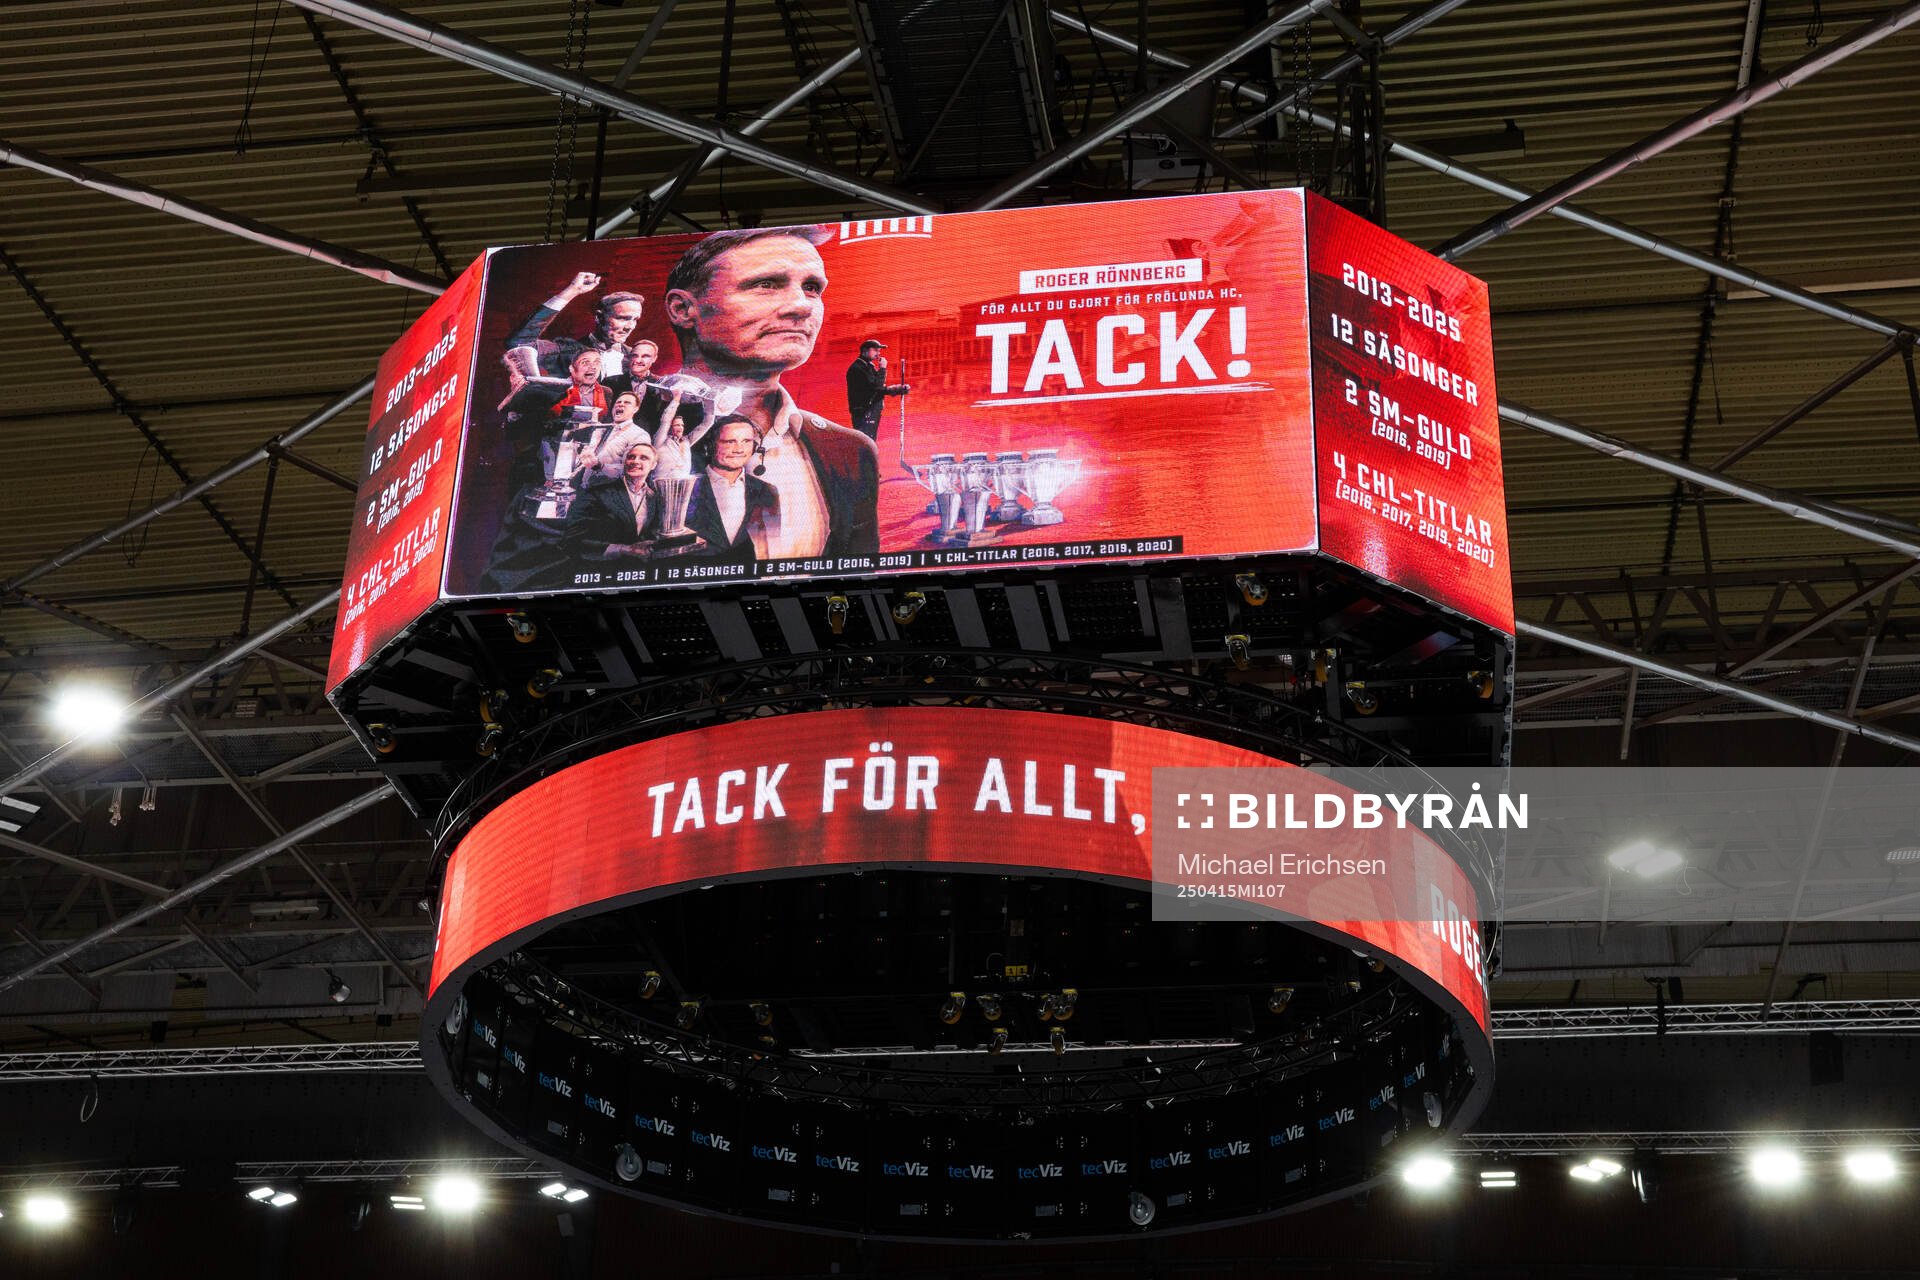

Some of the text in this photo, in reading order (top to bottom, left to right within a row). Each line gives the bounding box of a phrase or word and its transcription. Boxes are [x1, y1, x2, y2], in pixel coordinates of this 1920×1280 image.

[1035, 266, 1186, 288] ROGER RÖNNBERG
[981, 303, 1007, 315] FÖR
[1010, 302, 1041, 313] ALLT
[1047, 300, 1063, 311] DU
[1069, 297, 1110, 309] GJORT
[1116, 292, 1140, 305] FÖR
[1146, 288, 1214, 303] FRÖLUNDA
[1342, 262, 1461, 342] 2013-2025
[975, 306, 1252, 394] TACK!
[1331, 313, 1478, 406] 12 SÄSONGER
[385, 325, 458, 413] 2013-2025
[369, 374, 458, 476] 12 SÄSONGER
[1345, 378, 1472, 460] 2 SM-GULD
[366, 438, 443, 527] 2 SM-GULD
[1333, 451, 1492, 547] 4 CHL-TITLAR
[347, 506, 441, 606] 4 CHL-TITLAR
[574, 573, 601, 584] 2013
[616, 570, 646, 581] 2025
[668, 568, 680, 579] 12
[684, 563, 745, 578] SÄSONGER
[766, 562, 774, 573] 2
[779, 559, 833, 572] SM-GULD
[934, 553, 942, 564] 4
[946, 549, 1017, 563] CHL-TITLAR
[647, 741, 1146, 838] TACK FÖR ALLT,
[473, 1018, 497, 1048] tecViz
[503, 1044, 528, 1075] tecViz
[539, 1071, 572, 1098] tecViz
[1403, 1061, 1425, 1088] tecVi
[584, 1091, 617, 1119] tecViz
[1368, 1085, 1395, 1112] tecViz
[634, 1112, 675, 1137] tecViz
[1318, 1107, 1355, 1130] tecViz
[690, 1128, 731, 1152] tecViz
[1269, 1124, 1305, 1147] tecViz
[752, 1144, 797, 1163] tecViz
[816, 1153, 861, 1173] tecViz
[1150, 1150, 1192, 1170] tecViz
[1208, 1140, 1250, 1160] tecViz
[882, 1161, 929, 1177] tecViz
[947, 1163, 994, 1180] tecViz
[1017, 1163, 1063, 1179] tecViz
[1081, 1160, 1128, 1176] tecViz
